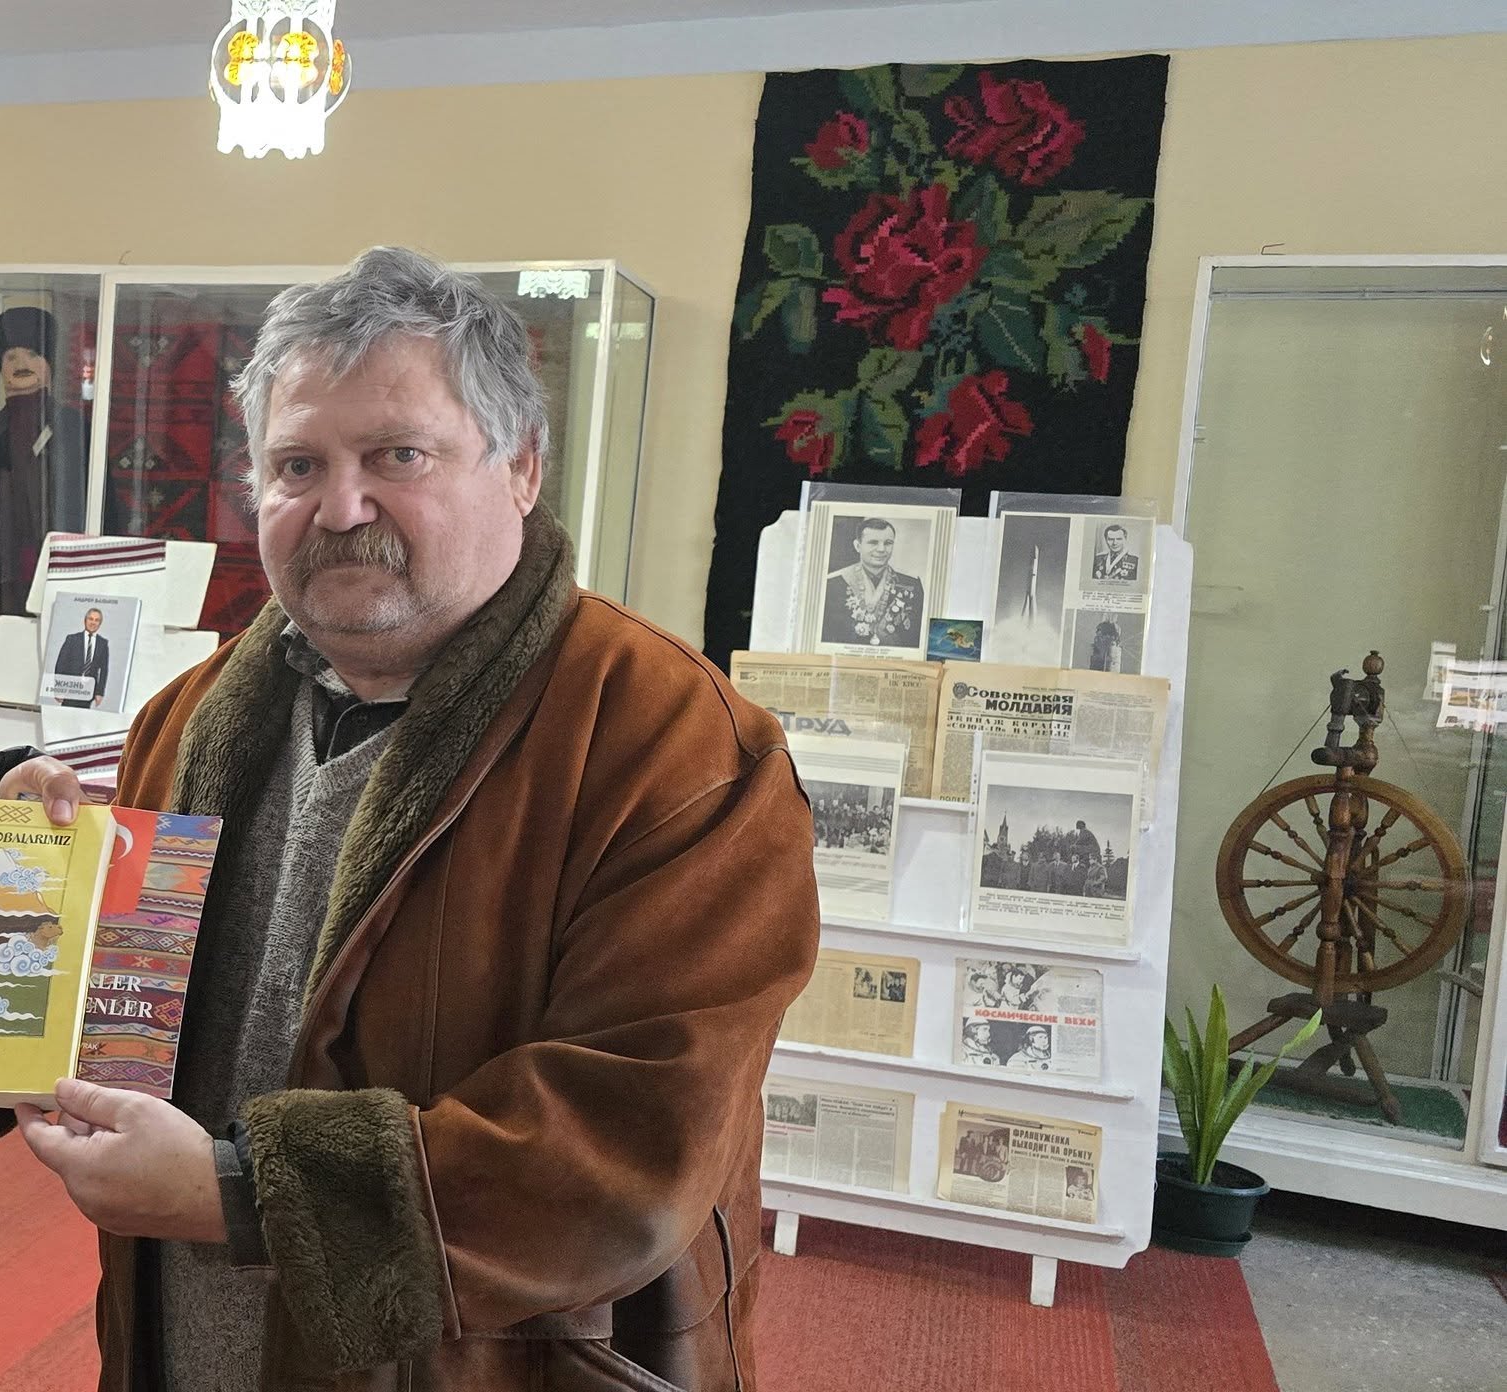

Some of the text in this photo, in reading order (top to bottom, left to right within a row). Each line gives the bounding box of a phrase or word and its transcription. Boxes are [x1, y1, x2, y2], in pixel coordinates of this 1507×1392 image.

[54, 680, 84, 689] ЖИЗНЬ
[967, 686, 1073, 703] Советская
[985, 699, 1073, 716] МОЛДАВИЯ
[975, 1009, 1096, 1026] КОСМИЧЕСКИЕ ВЕХИ
[1013, 1128, 1070, 1146] ФРАНЦУЖЕНКА
[1012, 1140, 1048, 1152] ВЫХОДИТ
[1050, 1146, 1061, 1155] НА
[1063, 1147, 1093, 1160] ОРБИТУ
